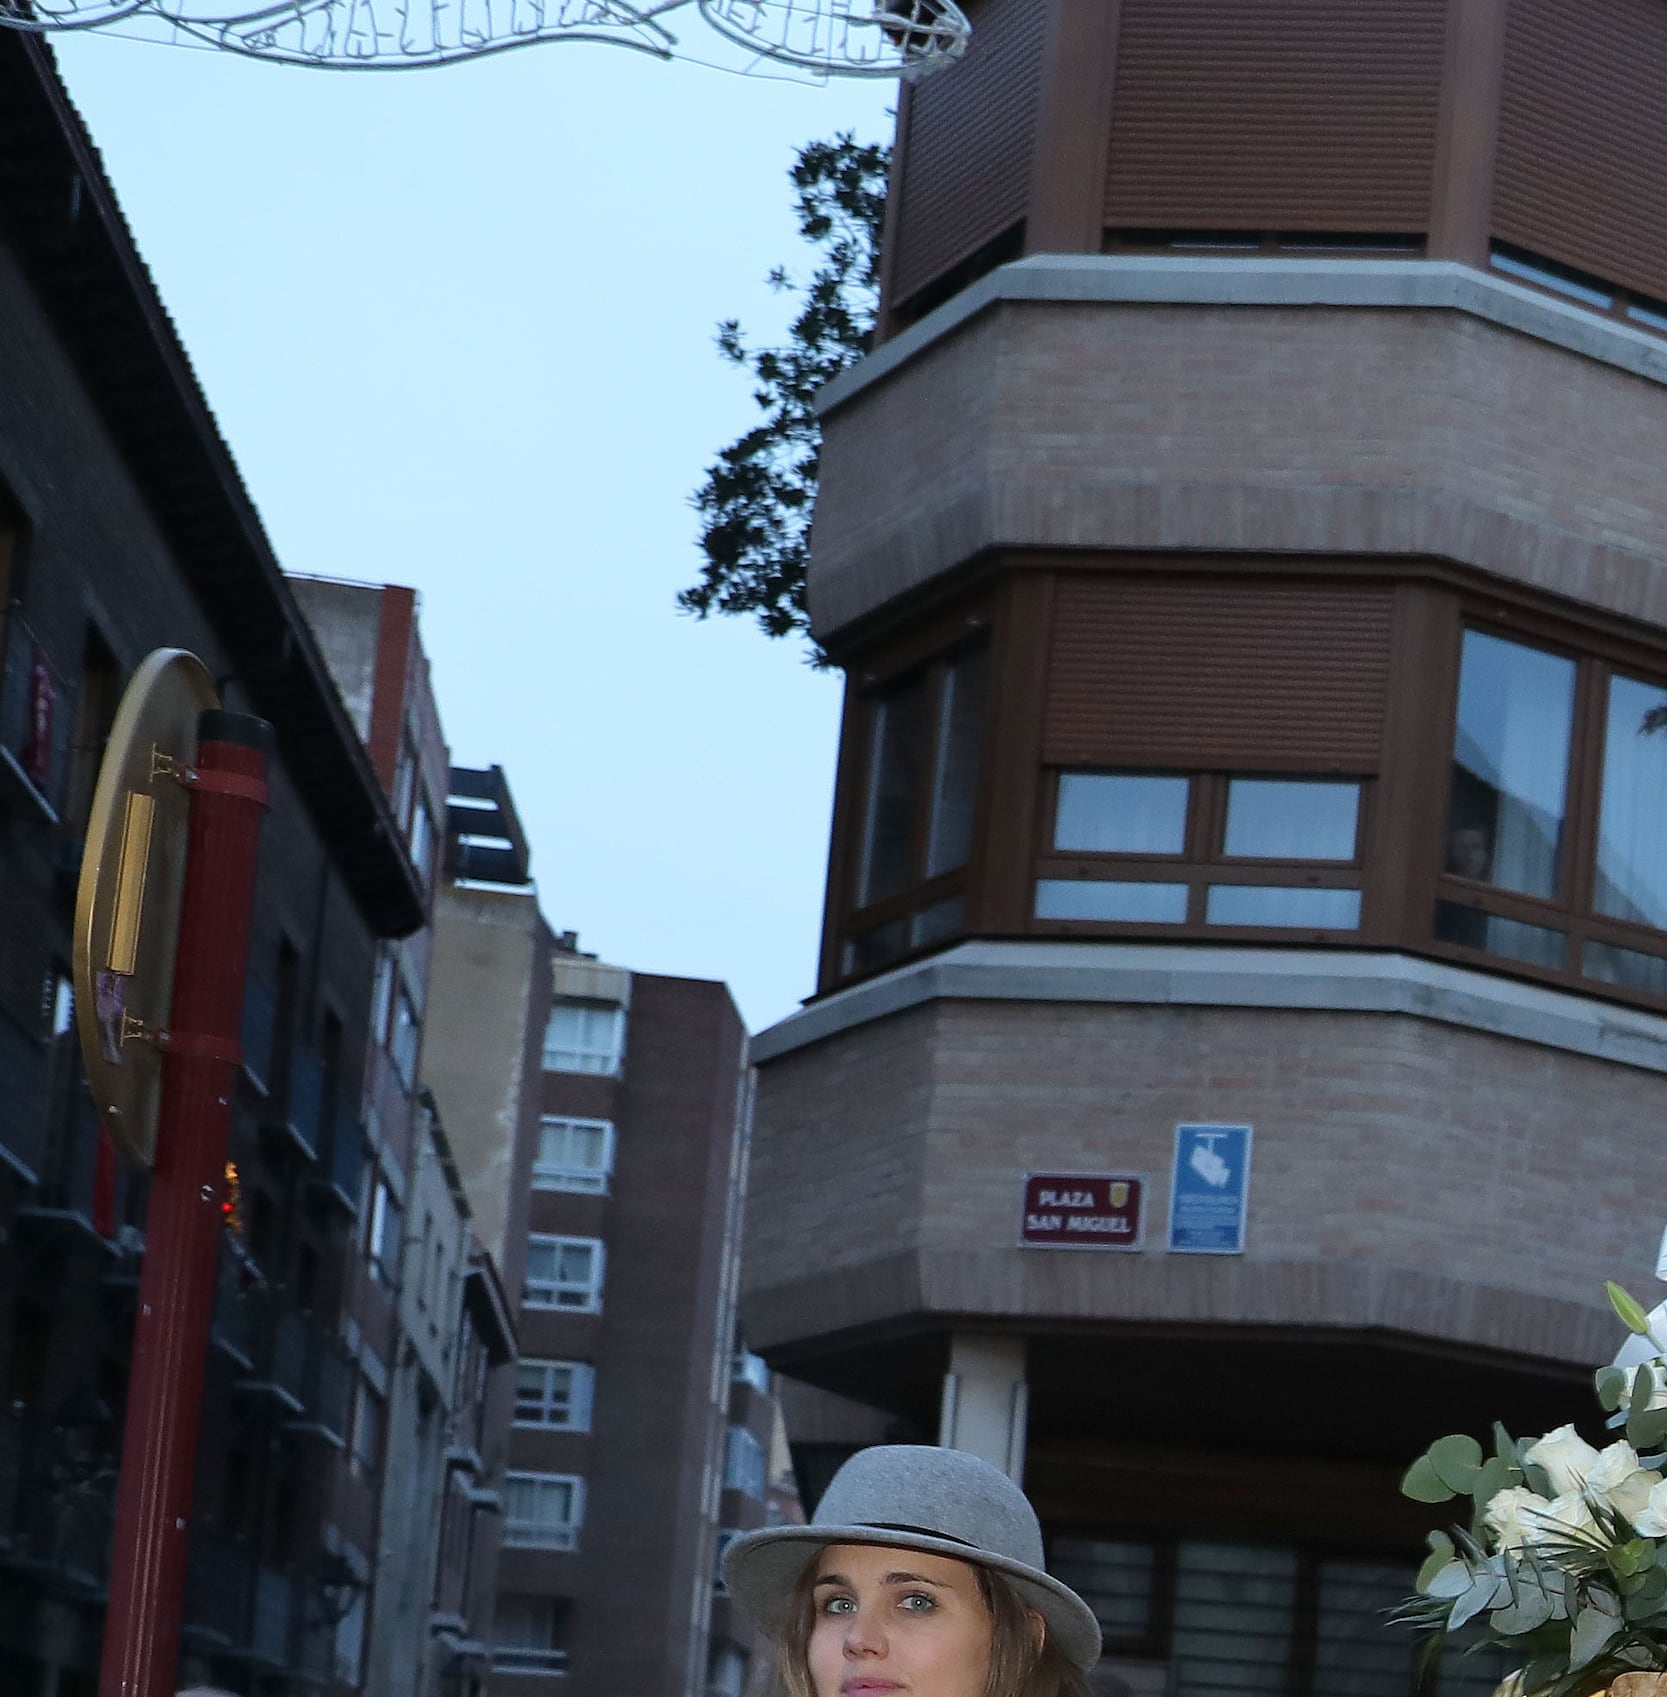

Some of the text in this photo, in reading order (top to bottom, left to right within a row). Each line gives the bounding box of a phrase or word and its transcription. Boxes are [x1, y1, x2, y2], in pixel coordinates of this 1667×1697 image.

[1039, 1190, 1095, 1207] PLAZA
[1026, 1214, 1131, 1233] SAN MIGUEL
